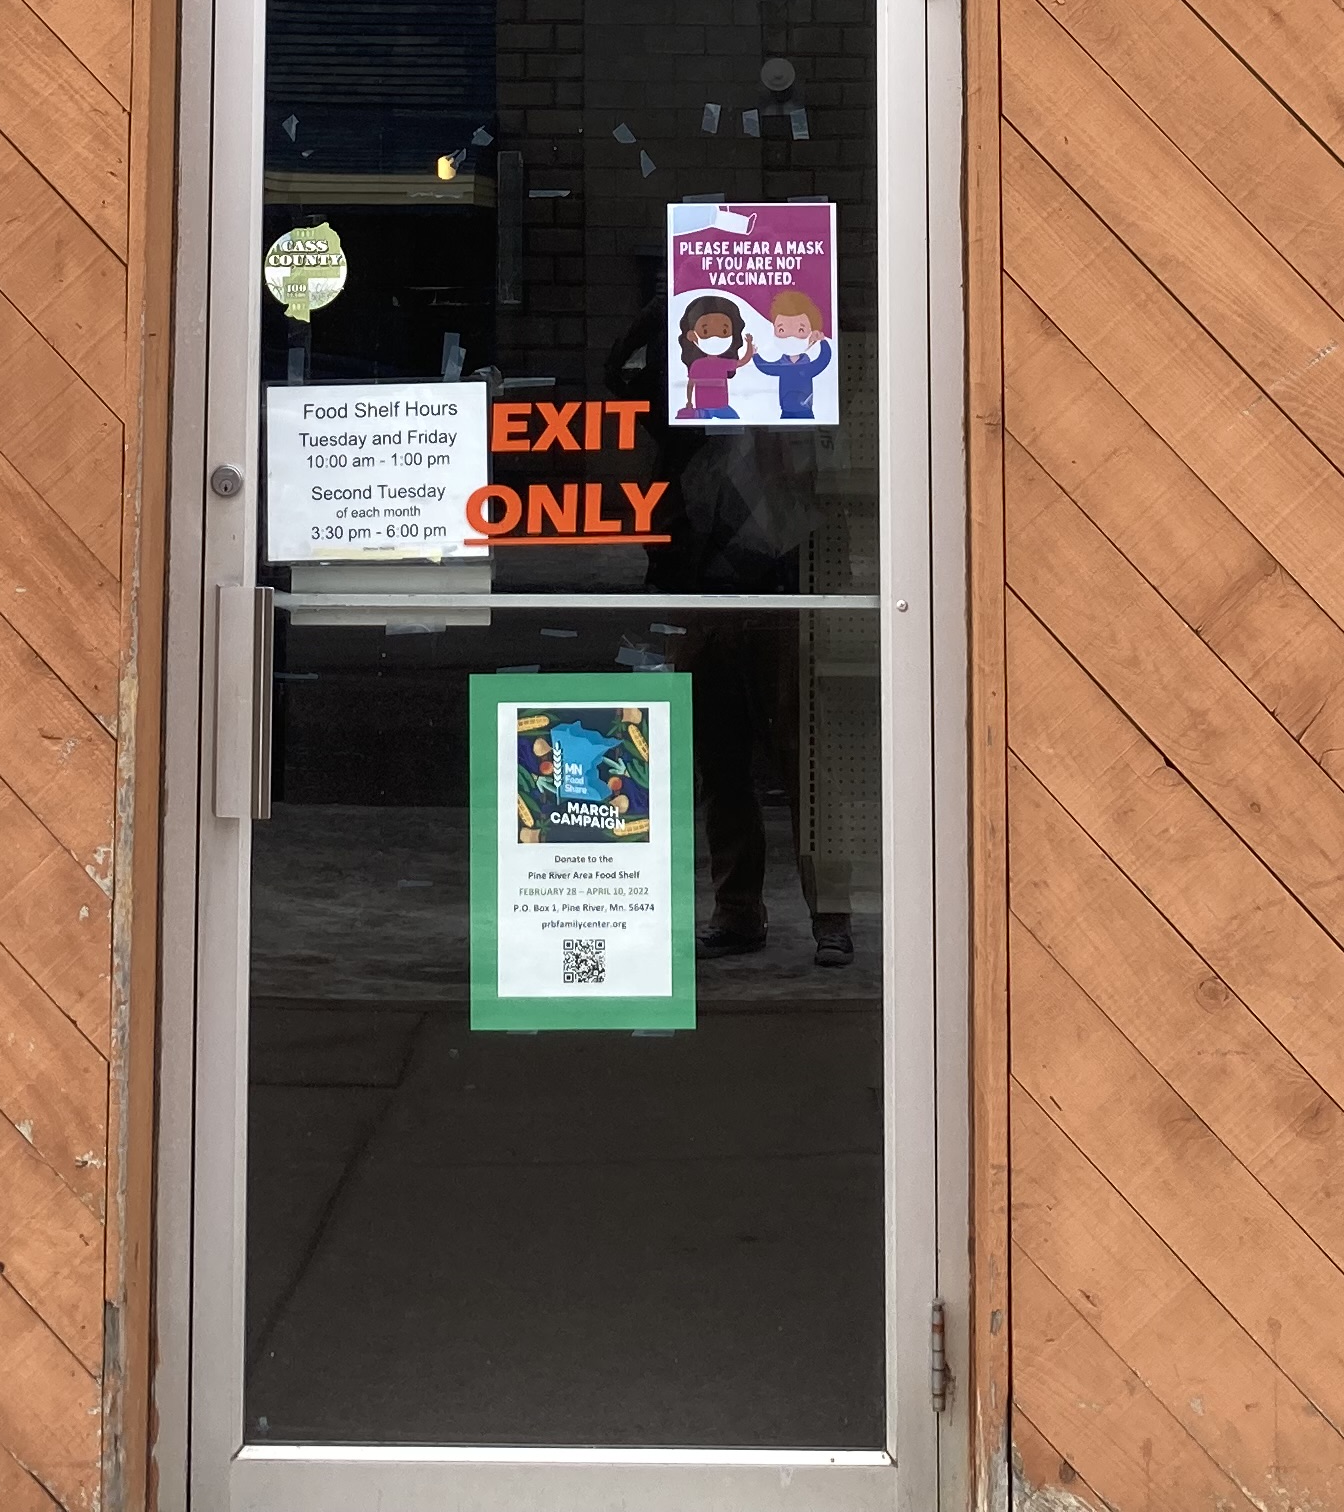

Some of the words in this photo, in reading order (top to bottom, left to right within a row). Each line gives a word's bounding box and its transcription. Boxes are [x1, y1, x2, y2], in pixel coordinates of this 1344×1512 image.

[281, 239, 329, 253] CASS
[679, 241, 730, 255] PLEASE
[733, 241, 771, 255] WEAR
[774, 241, 784, 255] A
[786, 240, 825, 255] MASK
[268, 254, 343, 268] COUNTY
[702, 256, 713, 271] IF
[716, 256, 743, 270] YOU
[746, 256, 773, 270] ARE
[776, 256, 803, 270] NOT
[708, 271, 796, 286] VACCINATED.
[303, 402, 348, 420] Food
[354, 401, 400, 418] Shelf
[405, 401, 458, 417] Hours
[490, 400, 650, 452] EXIT
[299, 431, 367, 450] Tuesday
[372, 430, 402, 445] and
[407, 429, 458, 447] Friday
[306, 454, 348, 469] 10:00
[352, 456, 375, 468] am
[391, 452, 423, 467] 1:00
[427, 453, 450, 469] pm
[311, 484, 372, 501] Second
[376, 483, 446, 501] Tuesday
[336, 507, 348, 519] of
[351, 507, 380, 519] each
[383, 506, 421, 518] month
[465, 481, 671, 536] ONLY
[311, 525, 344, 541] 3:30
[348, 527, 372, 542] pm
[386, 524, 419, 538] 6:00
[424, 525, 447, 540] pm
[564, 763, 583, 776] MN
[564, 775, 584, 785] Food
[567, 801, 619, 818] MARCH
[550, 812, 626, 831] CAMPAIGN
[554, 855, 586, 864] Donate
[599, 855, 613, 863] the
[528, 872, 547, 880] Pine
[549, 871, 570, 880] River
[573, 871, 593, 879] Area
[595, 871, 616, 879] Food
[618, 870, 641, 879] Shelf
[519, 888, 564, 896] FEBRUARY
[566, 888, 577, 896] 28
[586, 887, 611, 896] APRIL
[628, 886, 649, 896] 2022
[533, 904, 549, 912] Box
[562, 903, 581, 912] Pine
